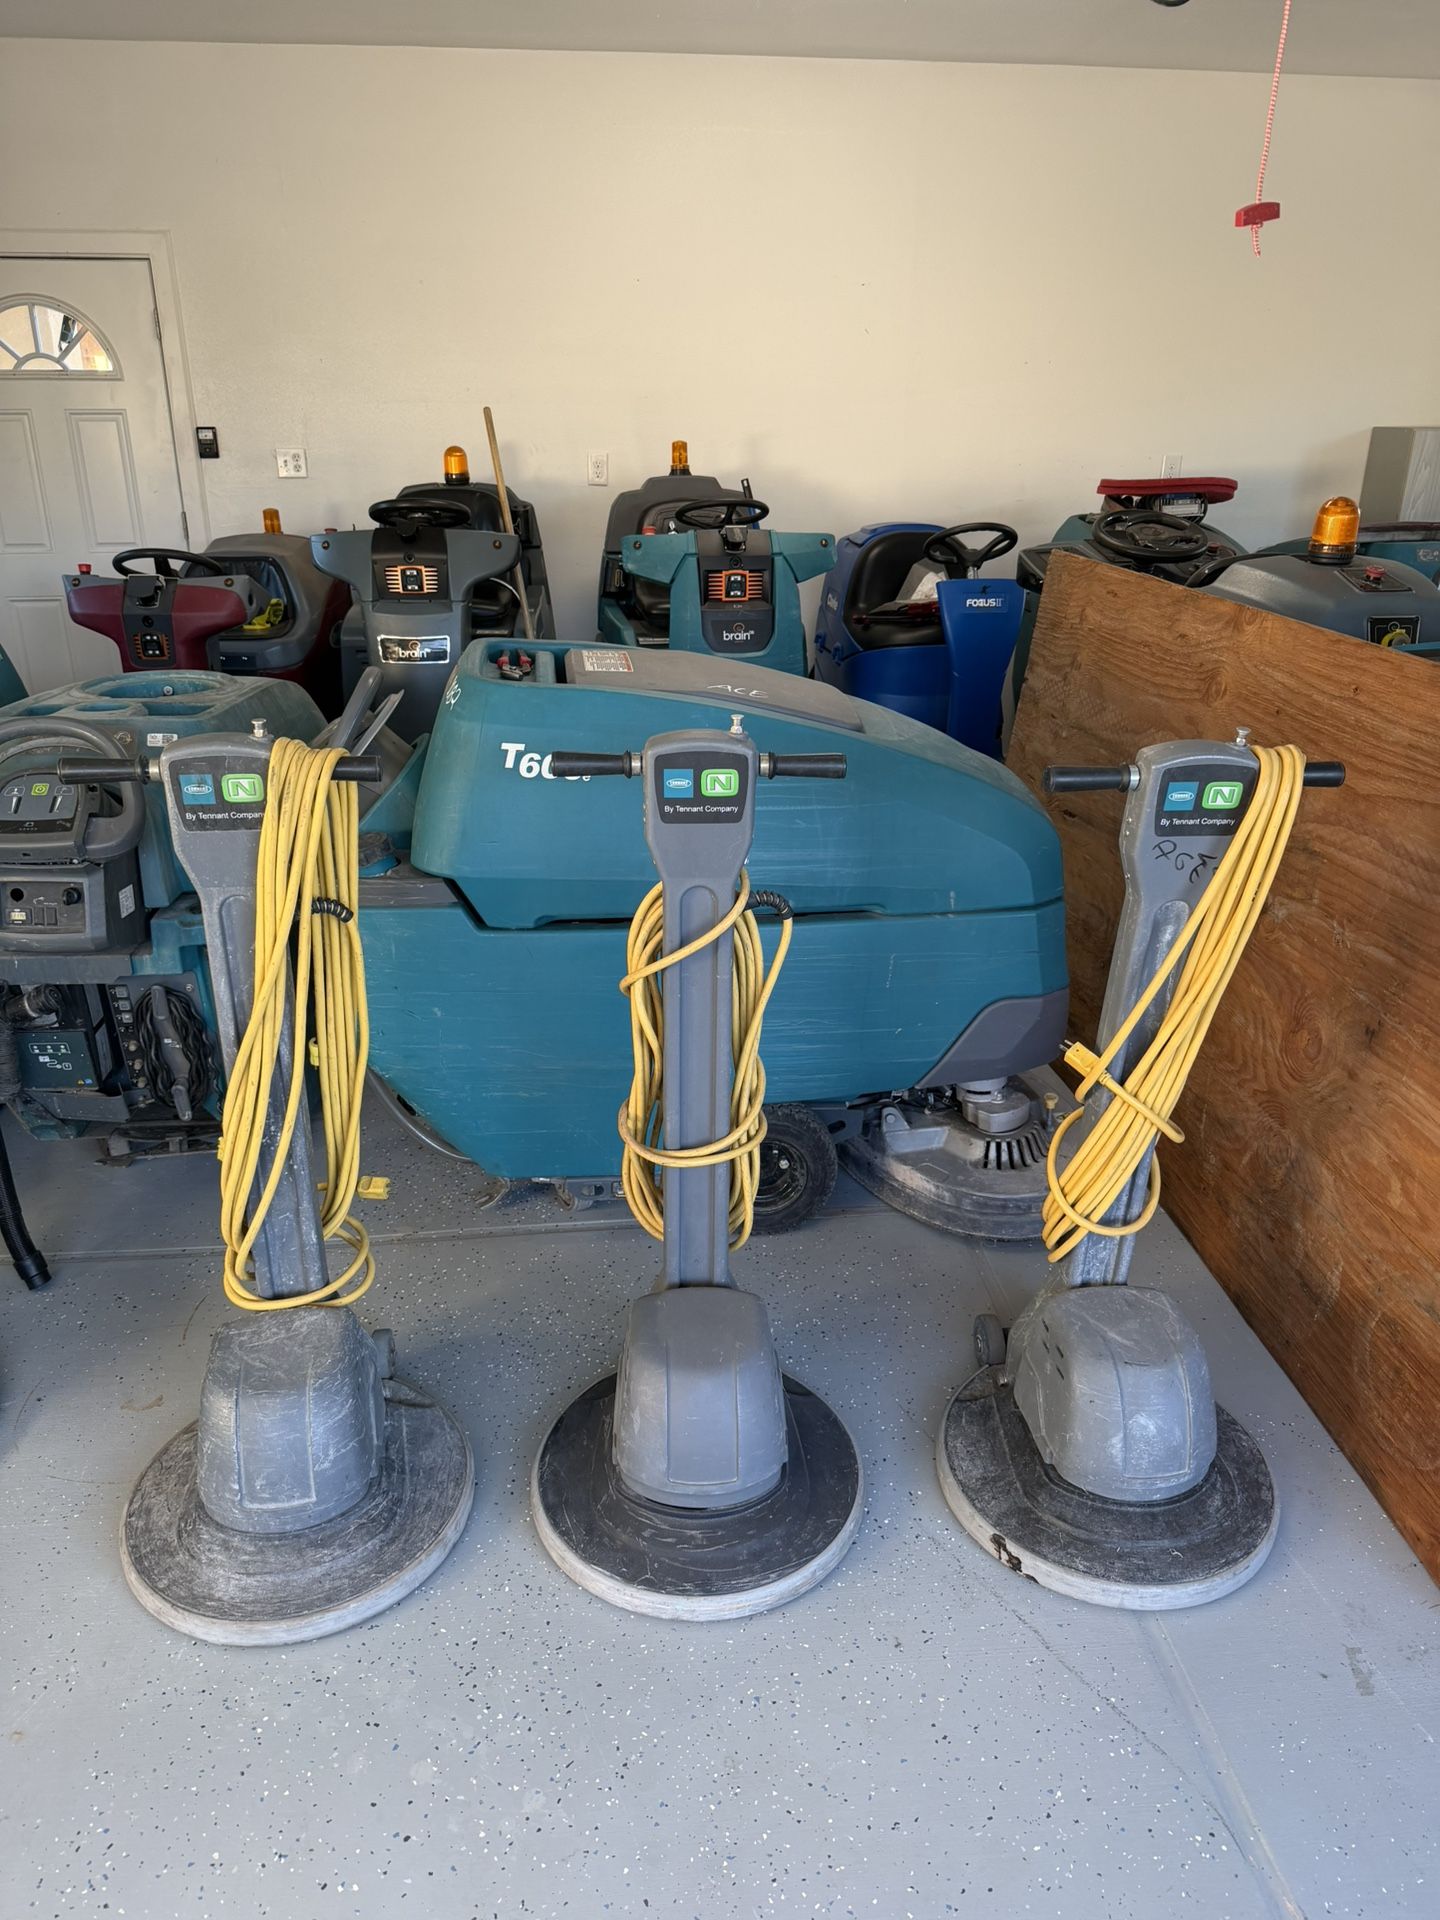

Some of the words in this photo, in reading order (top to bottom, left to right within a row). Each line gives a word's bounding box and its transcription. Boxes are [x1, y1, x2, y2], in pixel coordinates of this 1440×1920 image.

[664, 805, 674, 814] By
[675, 805, 704, 813] Tennant
[704, 805, 739, 814] Company
[185, 812, 196, 821] By
[198, 812, 229, 820] Tennant
[1160, 818, 1170, 827] By
[1201, 817, 1235, 826] Company
